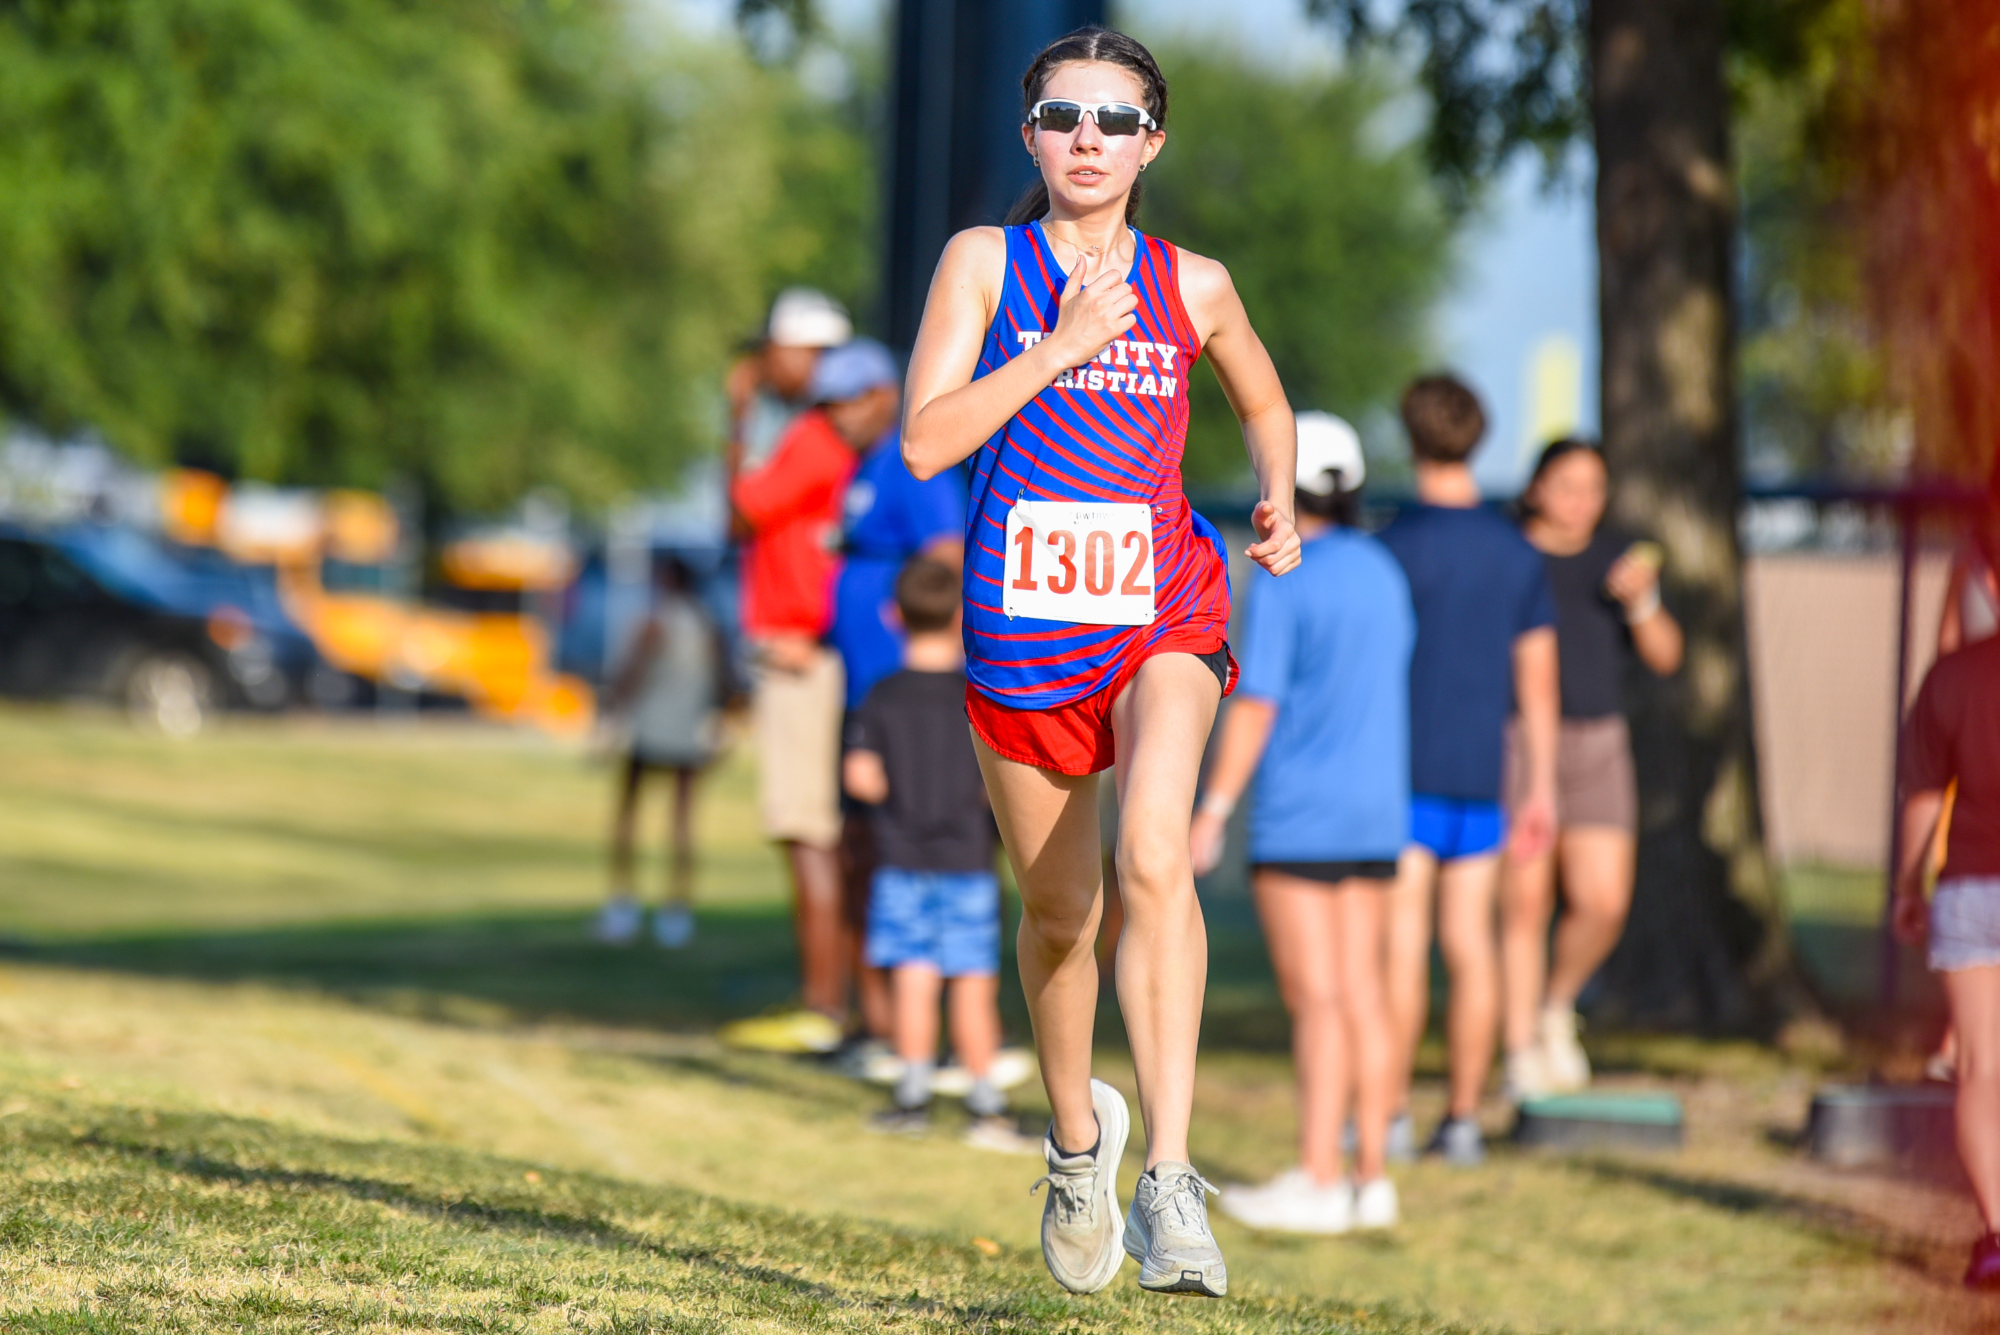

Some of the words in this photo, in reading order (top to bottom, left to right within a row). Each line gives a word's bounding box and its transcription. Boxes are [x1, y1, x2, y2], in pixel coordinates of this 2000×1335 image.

[1017, 330, 1178, 370] TNITY
[1048, 367, 1178, 398] RISTIAN
[1012, 526, 1151, 597] 1302
